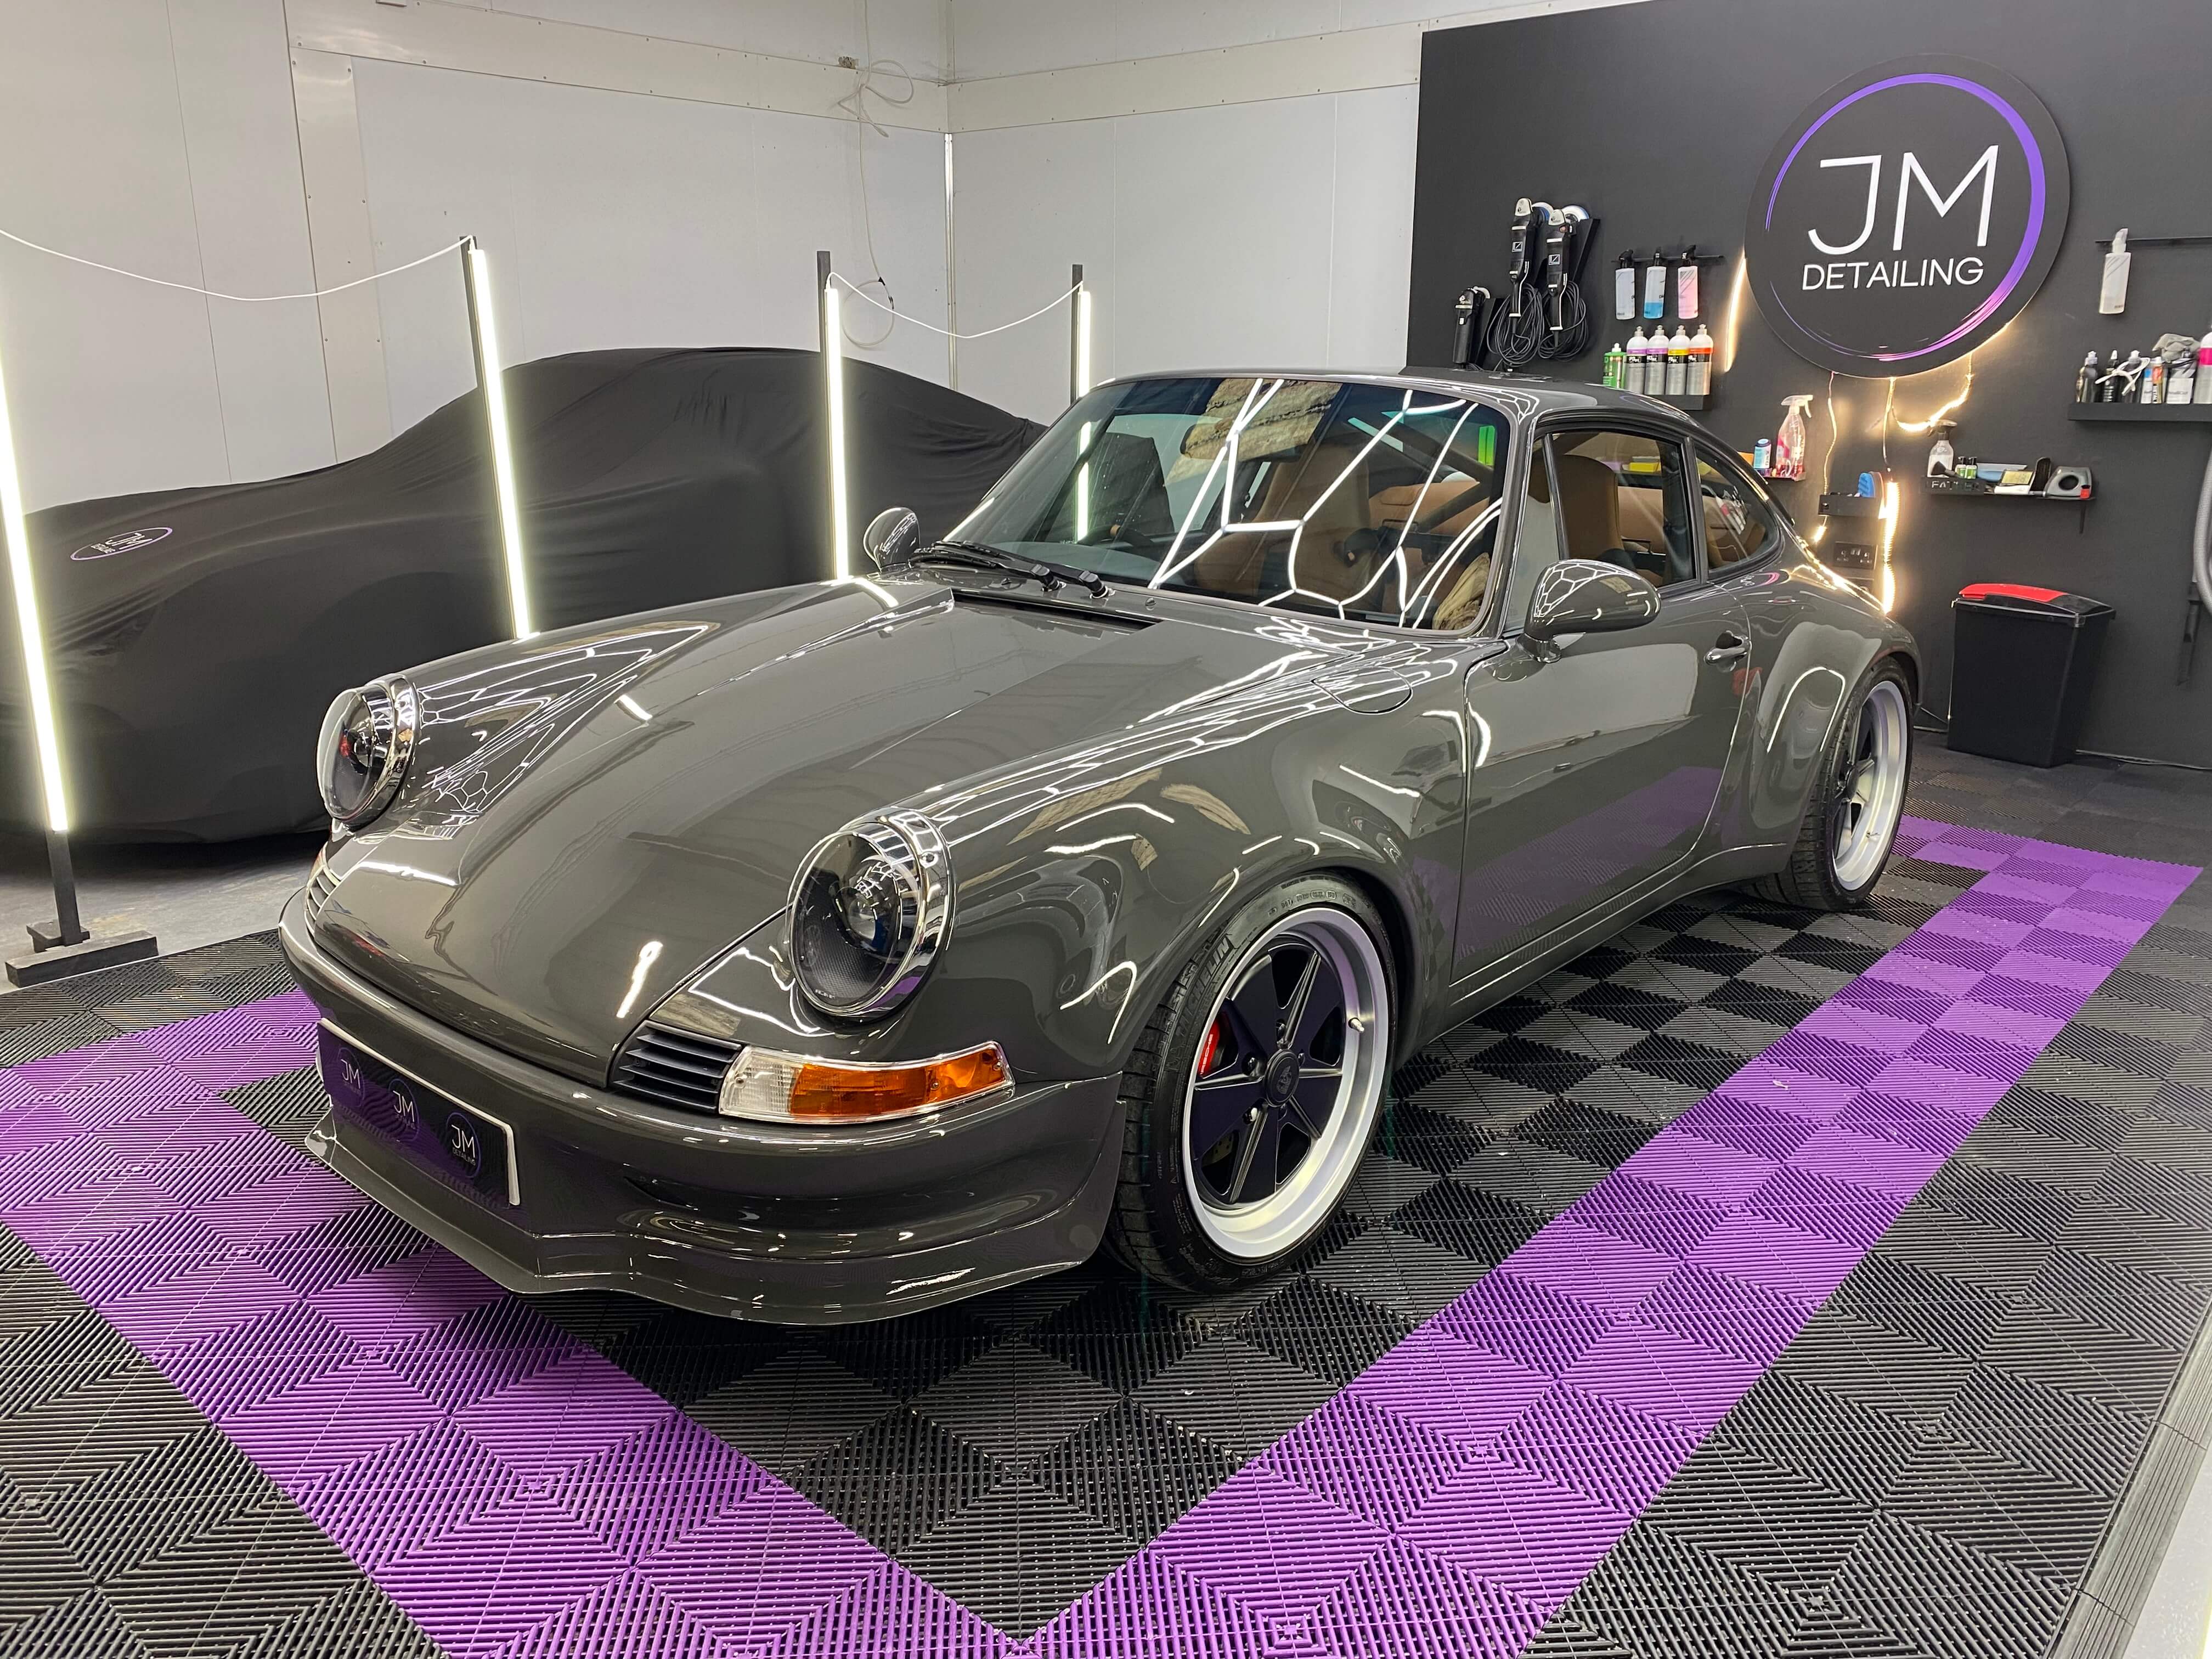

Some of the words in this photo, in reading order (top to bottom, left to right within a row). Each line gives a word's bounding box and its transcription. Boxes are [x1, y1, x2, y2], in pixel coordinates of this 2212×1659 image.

[1808, 145, 1999, 255] JM
[1802, 257, 1984, 290] DETAILING
[105, 532, 153, 550] JM
[341, 1058, 360, 1089] JM
[393, 1090, 415, 1122] JM
[451, 1124, 476, 1158] JM
